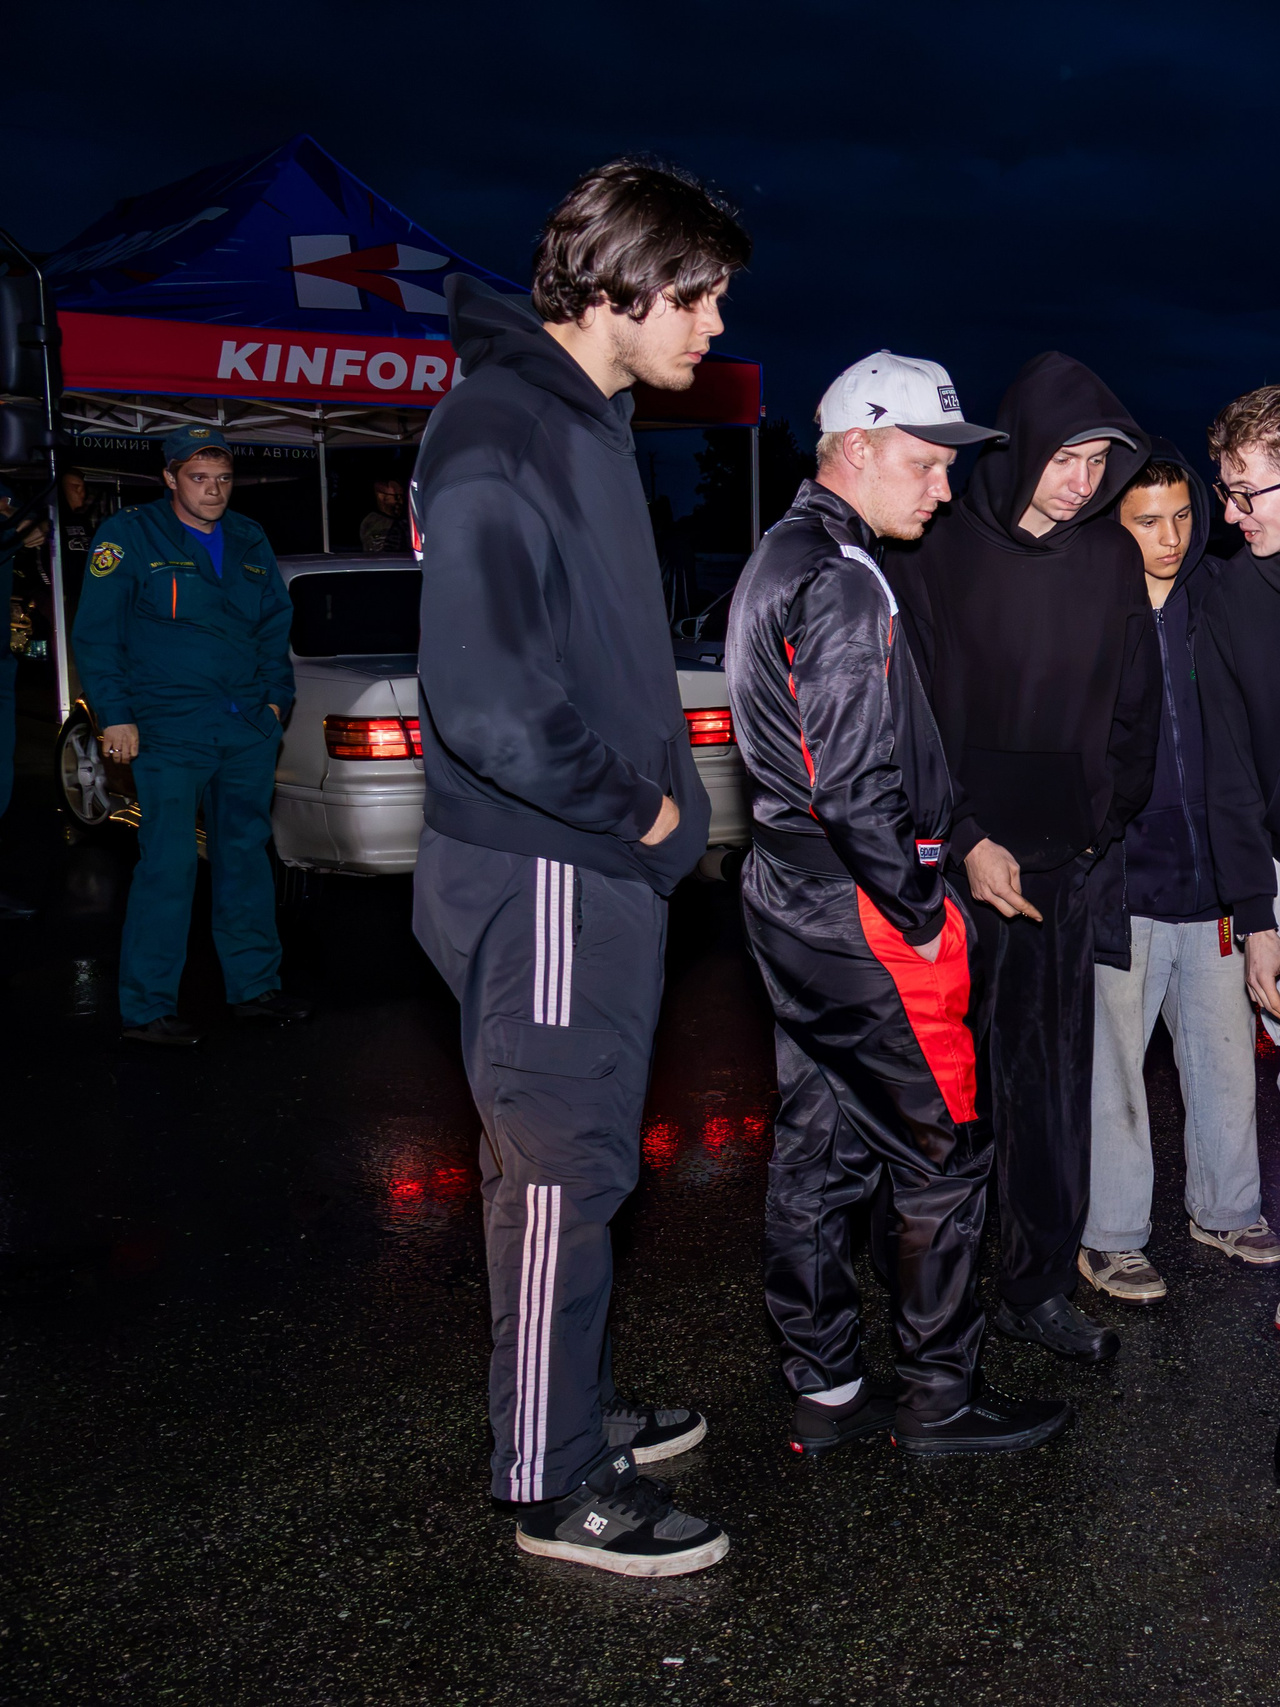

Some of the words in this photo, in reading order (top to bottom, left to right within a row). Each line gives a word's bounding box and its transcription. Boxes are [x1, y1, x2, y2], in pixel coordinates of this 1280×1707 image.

[216, 339, 467, 393] KINFOR
[73, 435, 151, 452] ТОХИМИЯ
[262, 447, 320, 459] АВТОХИ
